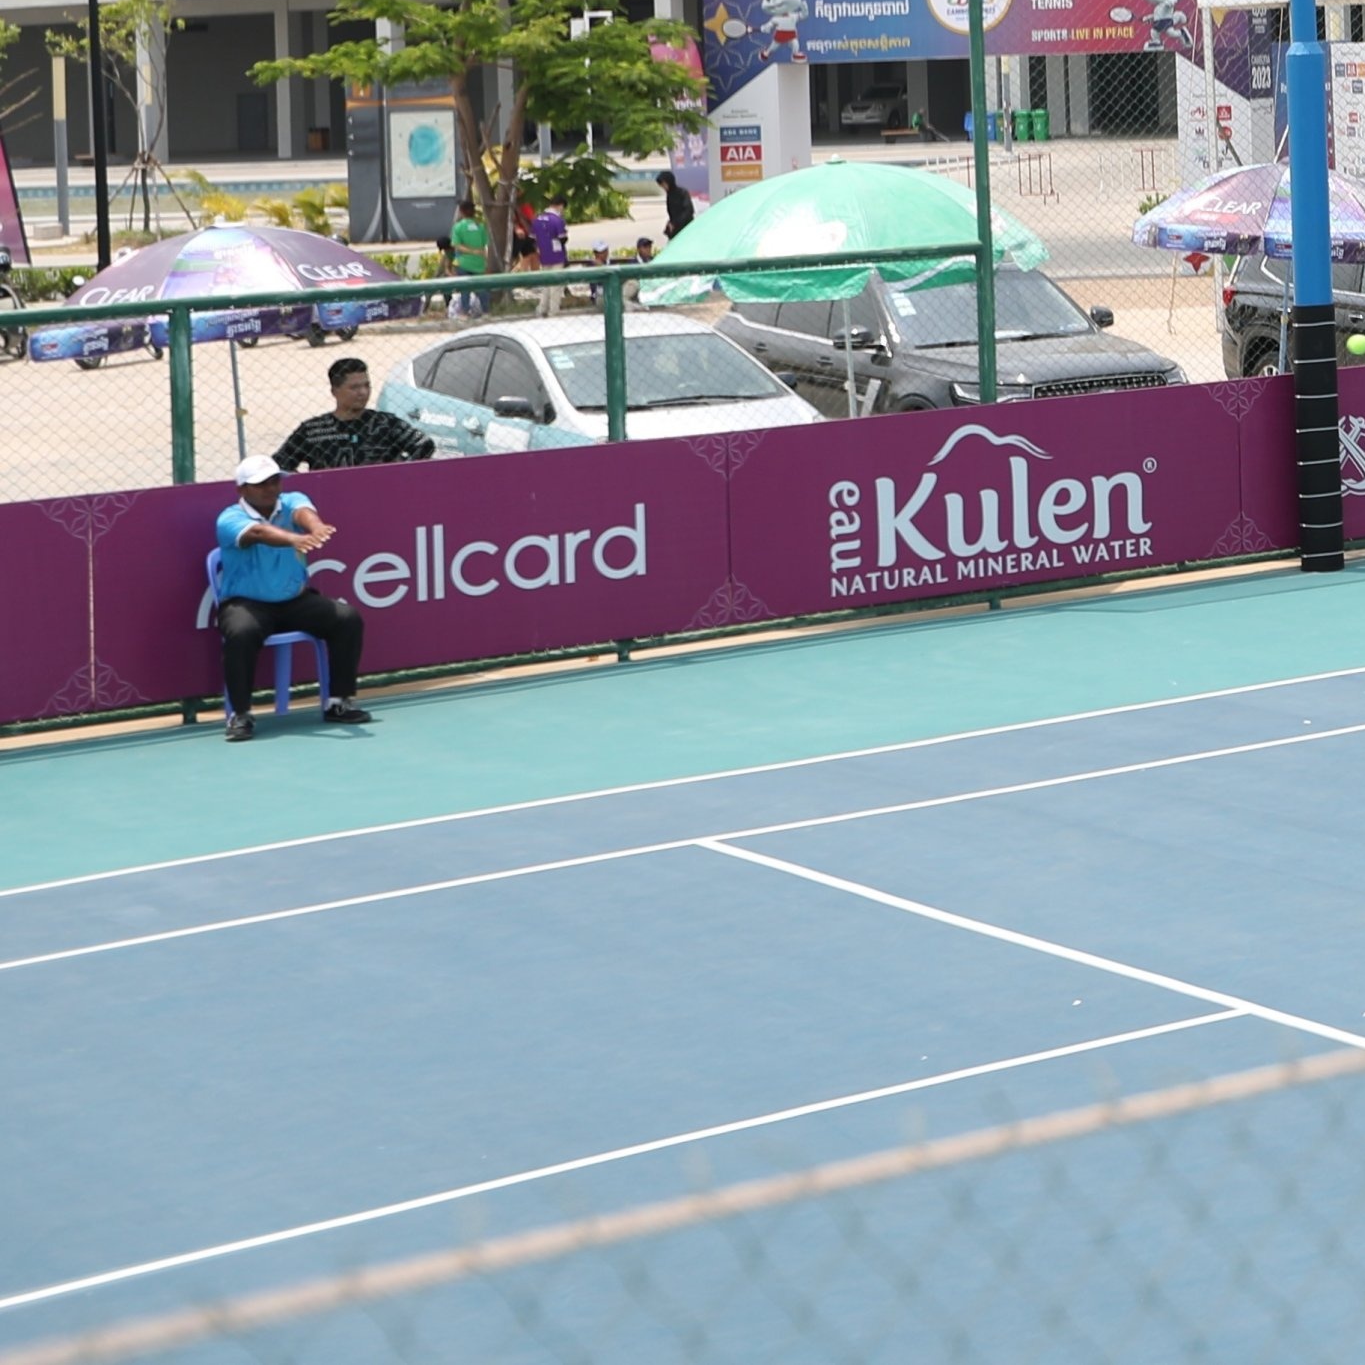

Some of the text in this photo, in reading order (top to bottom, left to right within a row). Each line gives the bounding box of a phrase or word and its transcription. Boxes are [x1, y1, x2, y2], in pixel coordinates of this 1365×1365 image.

[1252, 66, 1271, 89] 2023
[726, 146, 756, 161] AIA
[297, 262, 372, 282] CLEAR
[829, 480, 861, 574] eau
[874, 456, 1153, 567] Kulen
[831, 537, 1153, 597] NATURAL MINERAL WATER
